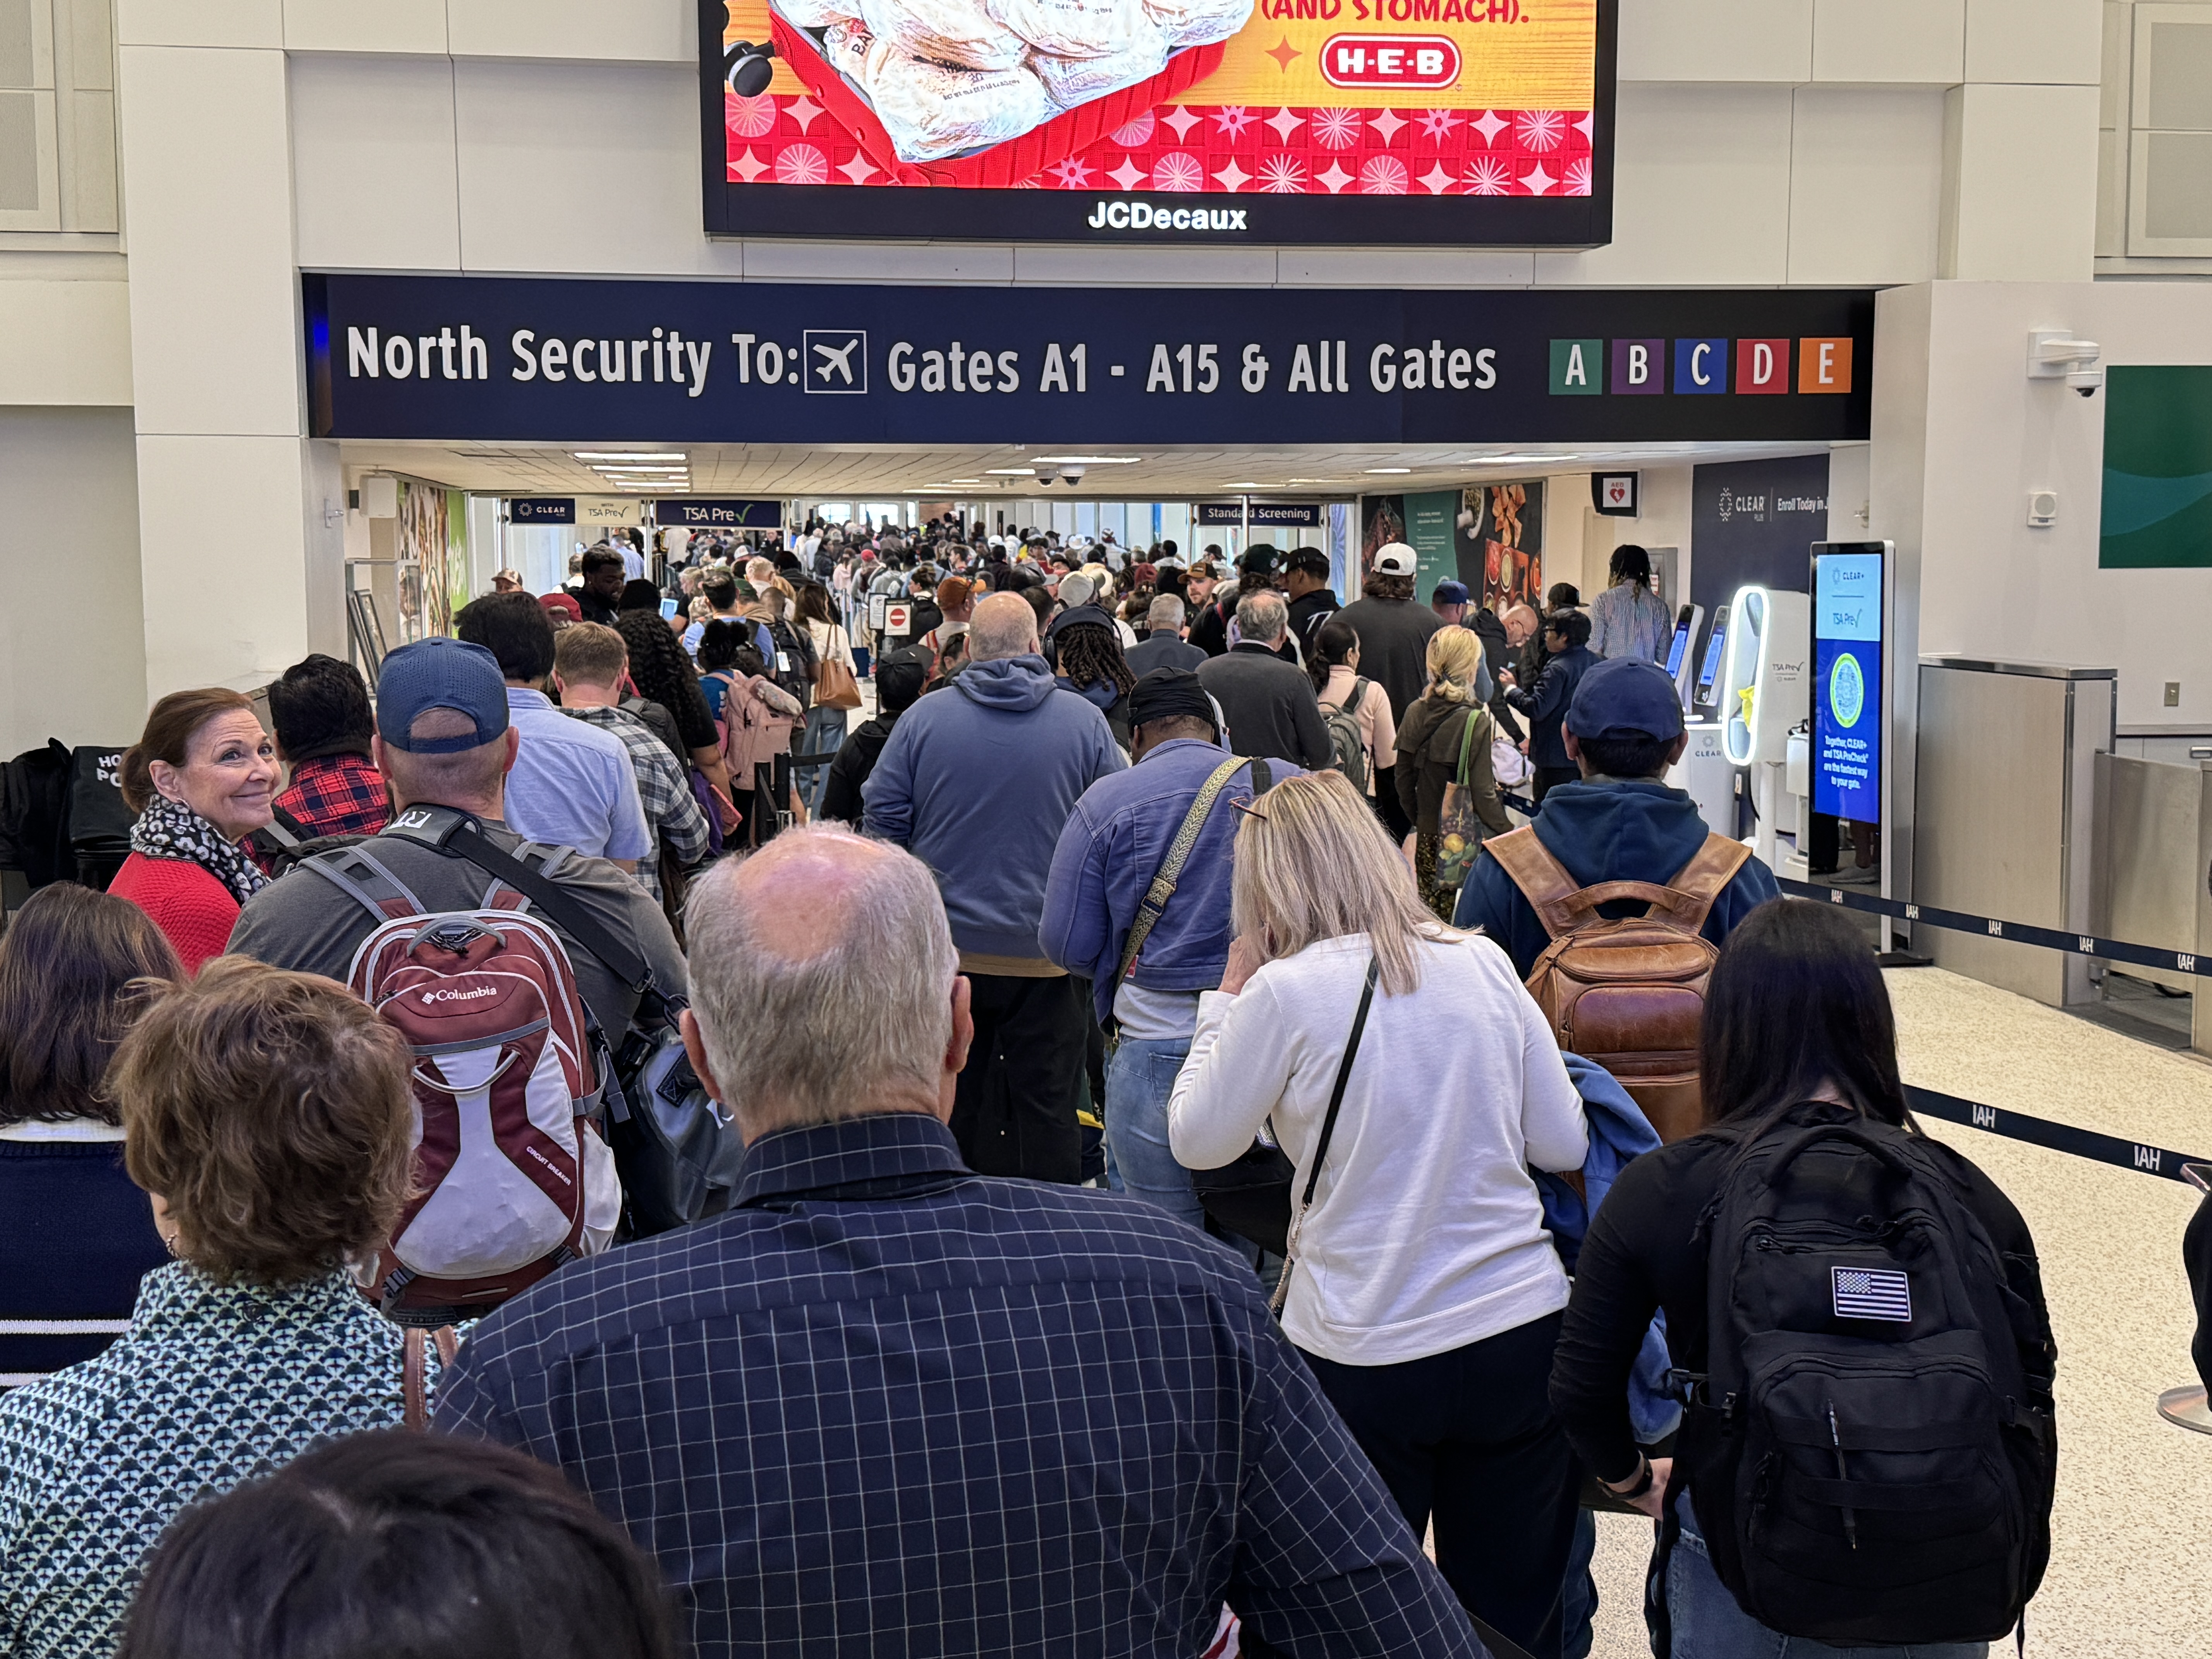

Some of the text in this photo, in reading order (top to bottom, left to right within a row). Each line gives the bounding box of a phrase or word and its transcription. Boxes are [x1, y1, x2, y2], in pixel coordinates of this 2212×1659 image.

[1261, 0, 1529, 24] (AND STOMACH).
[1088, 201, 1247, 230] JCDecaux
[348, 325, 488, 379] North
[512, 327, 711, 397] Security
[732, 333, 798, 384] To:
[888, 342, 1019, 393] Gates
[1040, 343, 1086, 392] A1
[1146, 344, 1219, 393] A15
[1241, 343, 1269, 393] &
[1288, 340, 1348, 392] All
[1370, 340, 1496, 393] Gates
[1565, 343, 1834, 385] A B C D E
[1736, 496, 1764, 512] CLEAR
[1778, 498, 1796, 511] Enroll
[1796, 497, 1816, 513] Today
[1817, 496, 1823, 510] in
[683, 507, 709, 520] TSA
[1208, 508, 1310, 521] Standad Screening
[1832, 749, 1843, 760] TSA
[1906, 904, 1918, 919] IAH
[1989, 919, 2002, 936] IAH
[2079, 936, 2094, 953] IAH
[2178, 953, 2195, 971] IAH
[436, 986, 497, 1001] Columbia
[1972, 1104, 1996, 1129] IAH
[527, 1146, 549, 1165] CIRCUIT
[2134, 1145, 2161, 1171] IAH
